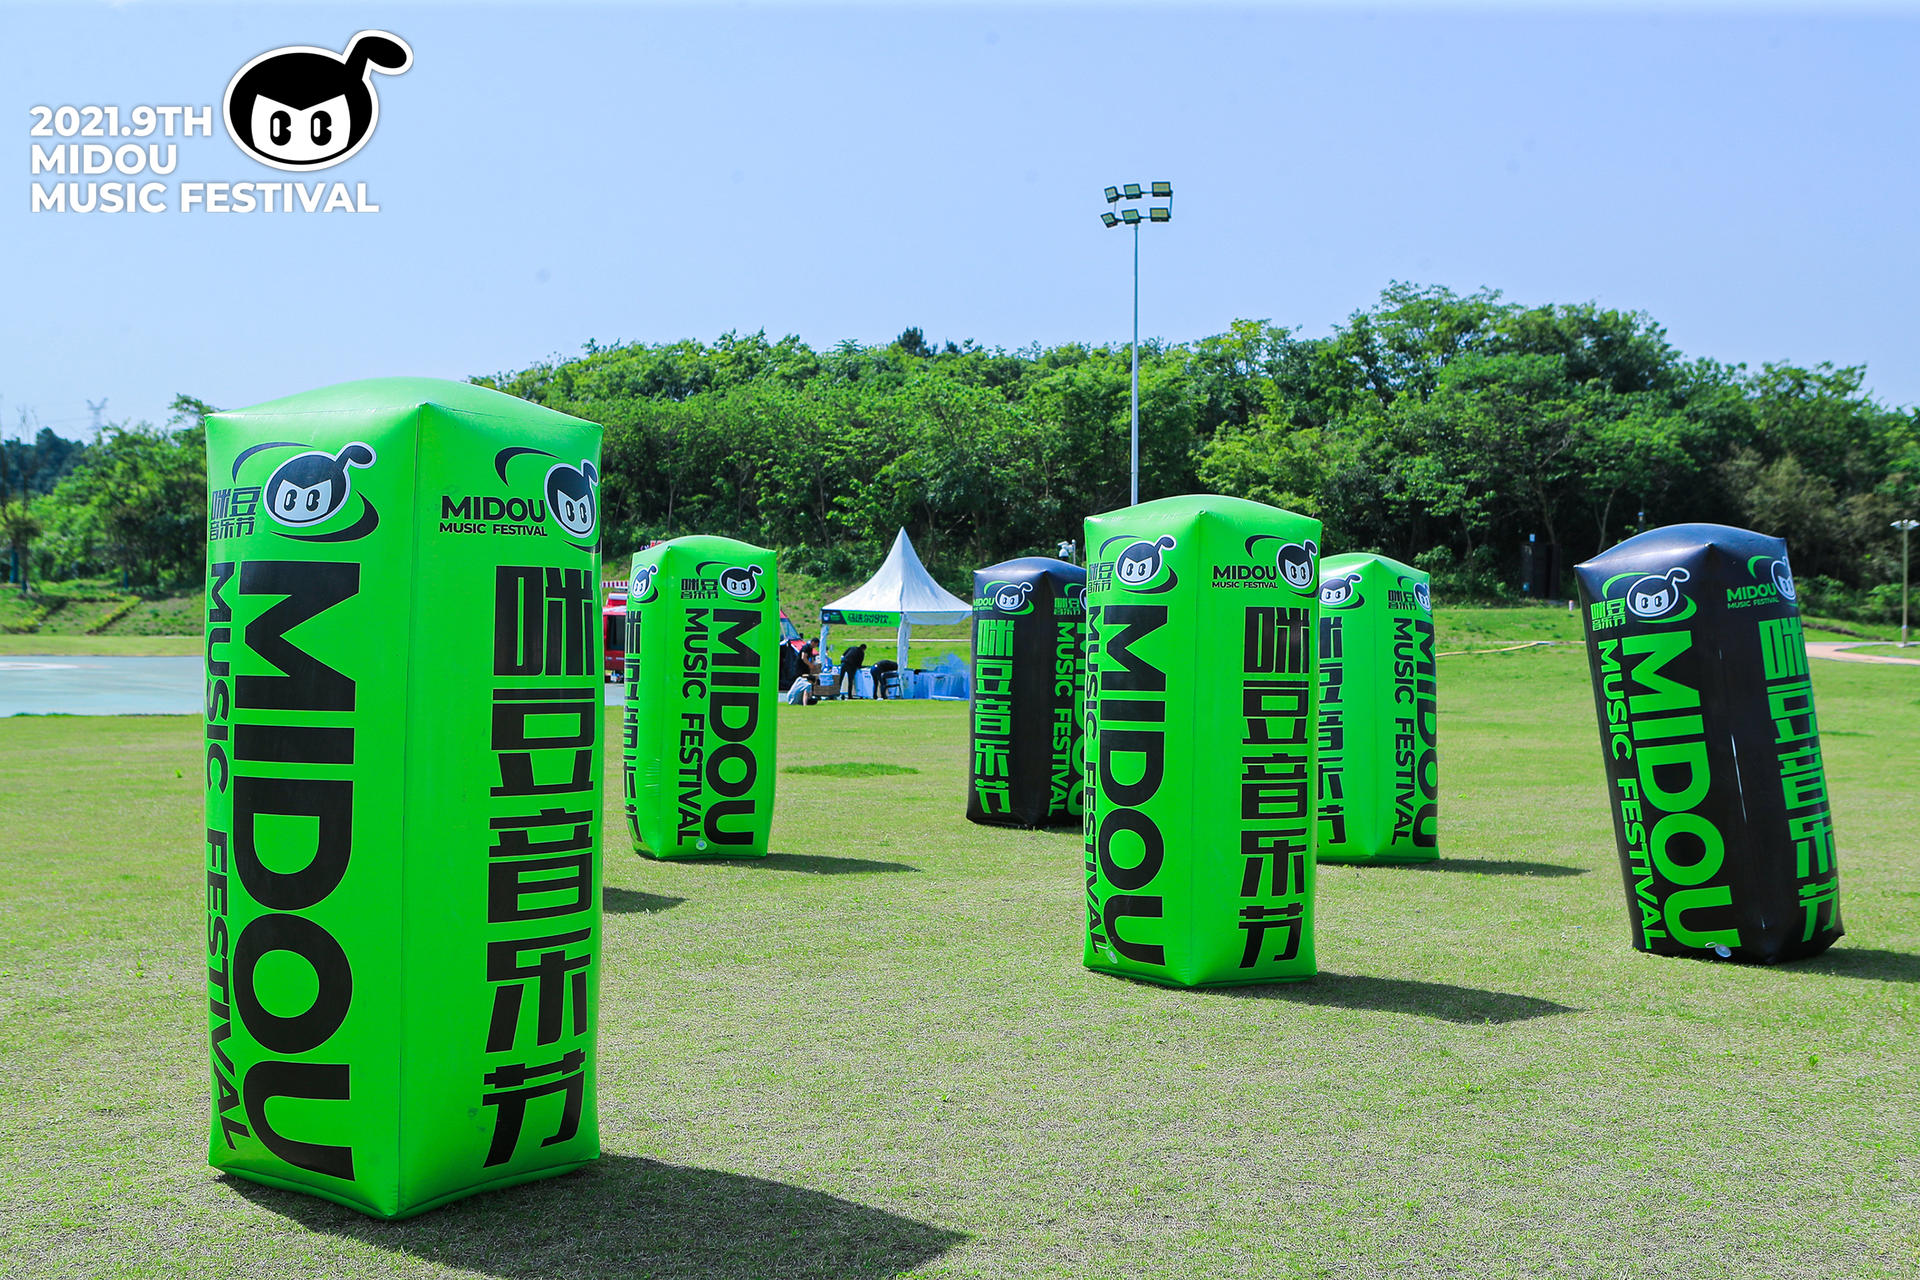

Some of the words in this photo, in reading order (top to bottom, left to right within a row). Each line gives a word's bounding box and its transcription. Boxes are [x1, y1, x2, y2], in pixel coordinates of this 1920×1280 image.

[439, 521, 487, 534] MUSIC
[492, 523, 548, 537] FESTIVAL
[441, 495, 546, 523] MIDOU
[1212, 565, 1278, 580] MIDOU
[1243, 581, 1278, 589] FESTIVAL
[1726, 583, 1777, 601] MIDOU
[1727, 600, 1752, 609] MUSIC
[206, 561, 235, 794] MUSIC
[682, 608, 710, 699] MUSIC
[974, 619, 1015, 814] 咪豆音乐节
[1054, 621, 1075, 697] MUSIC
[1085, 606, 1101, 740] MUSIC
[1393, 617, 1415, 705] MUSIC
[676, 713, 705, 846] FESTIVAL
[704, 608, 762, 846] MIDOU
[1048, 708, 1073, 817] FESTIVAL
[1099, 605, 1169, 966] MIDOU
[1239, 606, 1310, 969] 咪豆音乐节
[1390, 718, 1416, 846] FESTIVAL
[1412, 619, 1439, 848] MIDOU
[1622, 630, 1742, 948] MIDOU
[1084, 761, 1108, 954] FESTIVAL
[1597, 640, 1633, 760] MUSIC
[1617, 777, 1667, 949] FESTIVAL
[233, 560, 361, 1182] MIDOU
[483, 565, 596, 1168] 咪豆音乐节
[206, 827, 251, 1151] FESTIVAL
